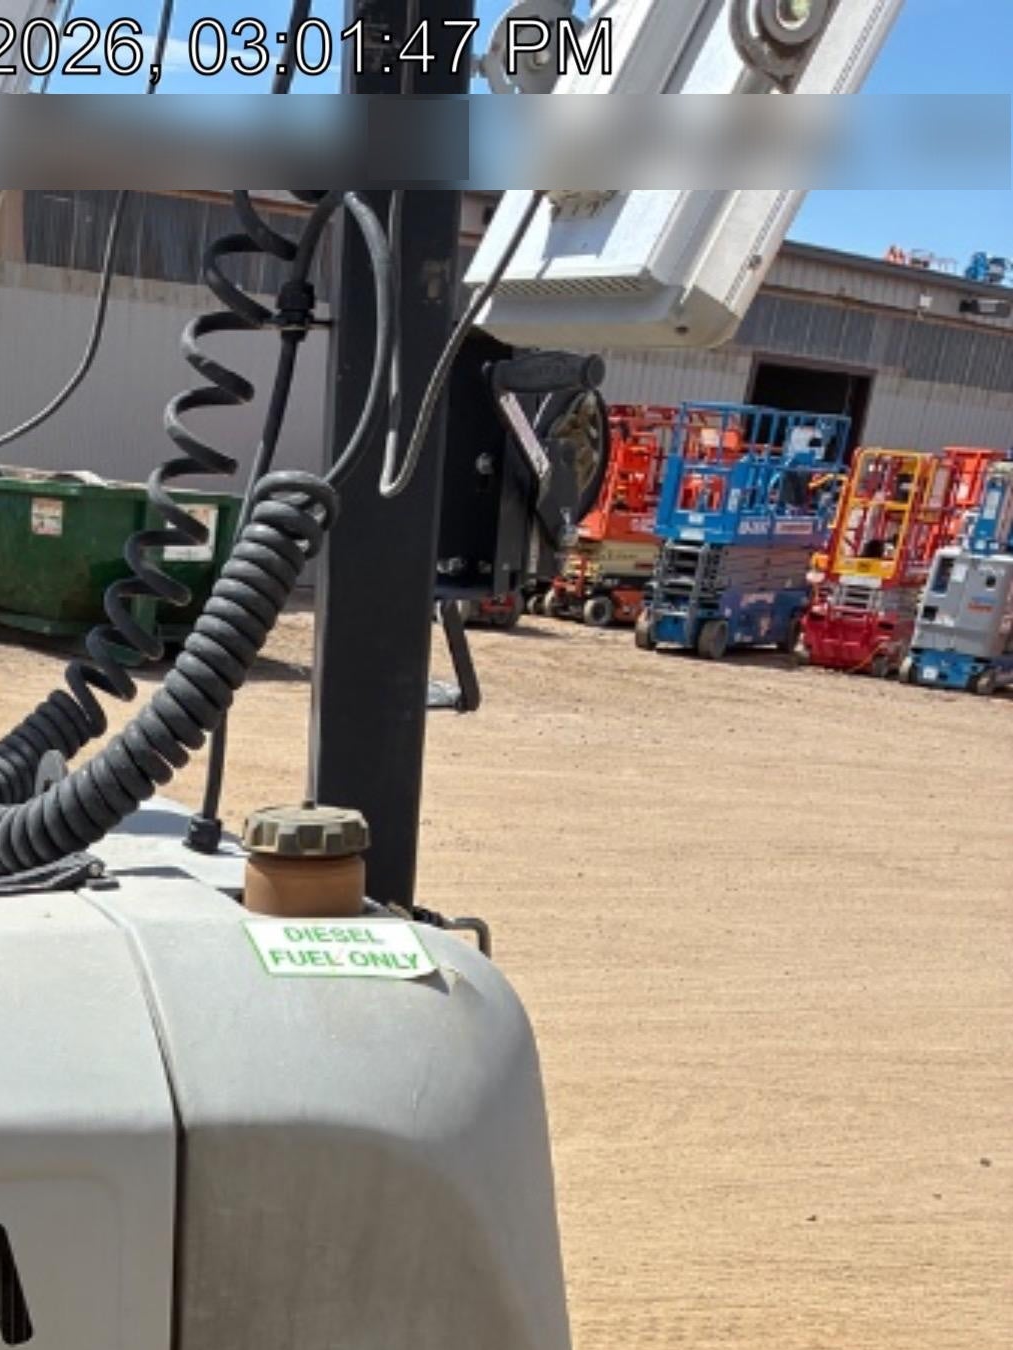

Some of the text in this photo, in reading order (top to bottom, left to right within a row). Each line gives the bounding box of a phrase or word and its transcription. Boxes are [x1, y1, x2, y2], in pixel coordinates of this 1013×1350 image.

[284, 926, 384, 944] DIESEL
[269, 949, 418, 969] FUEL ONLY
